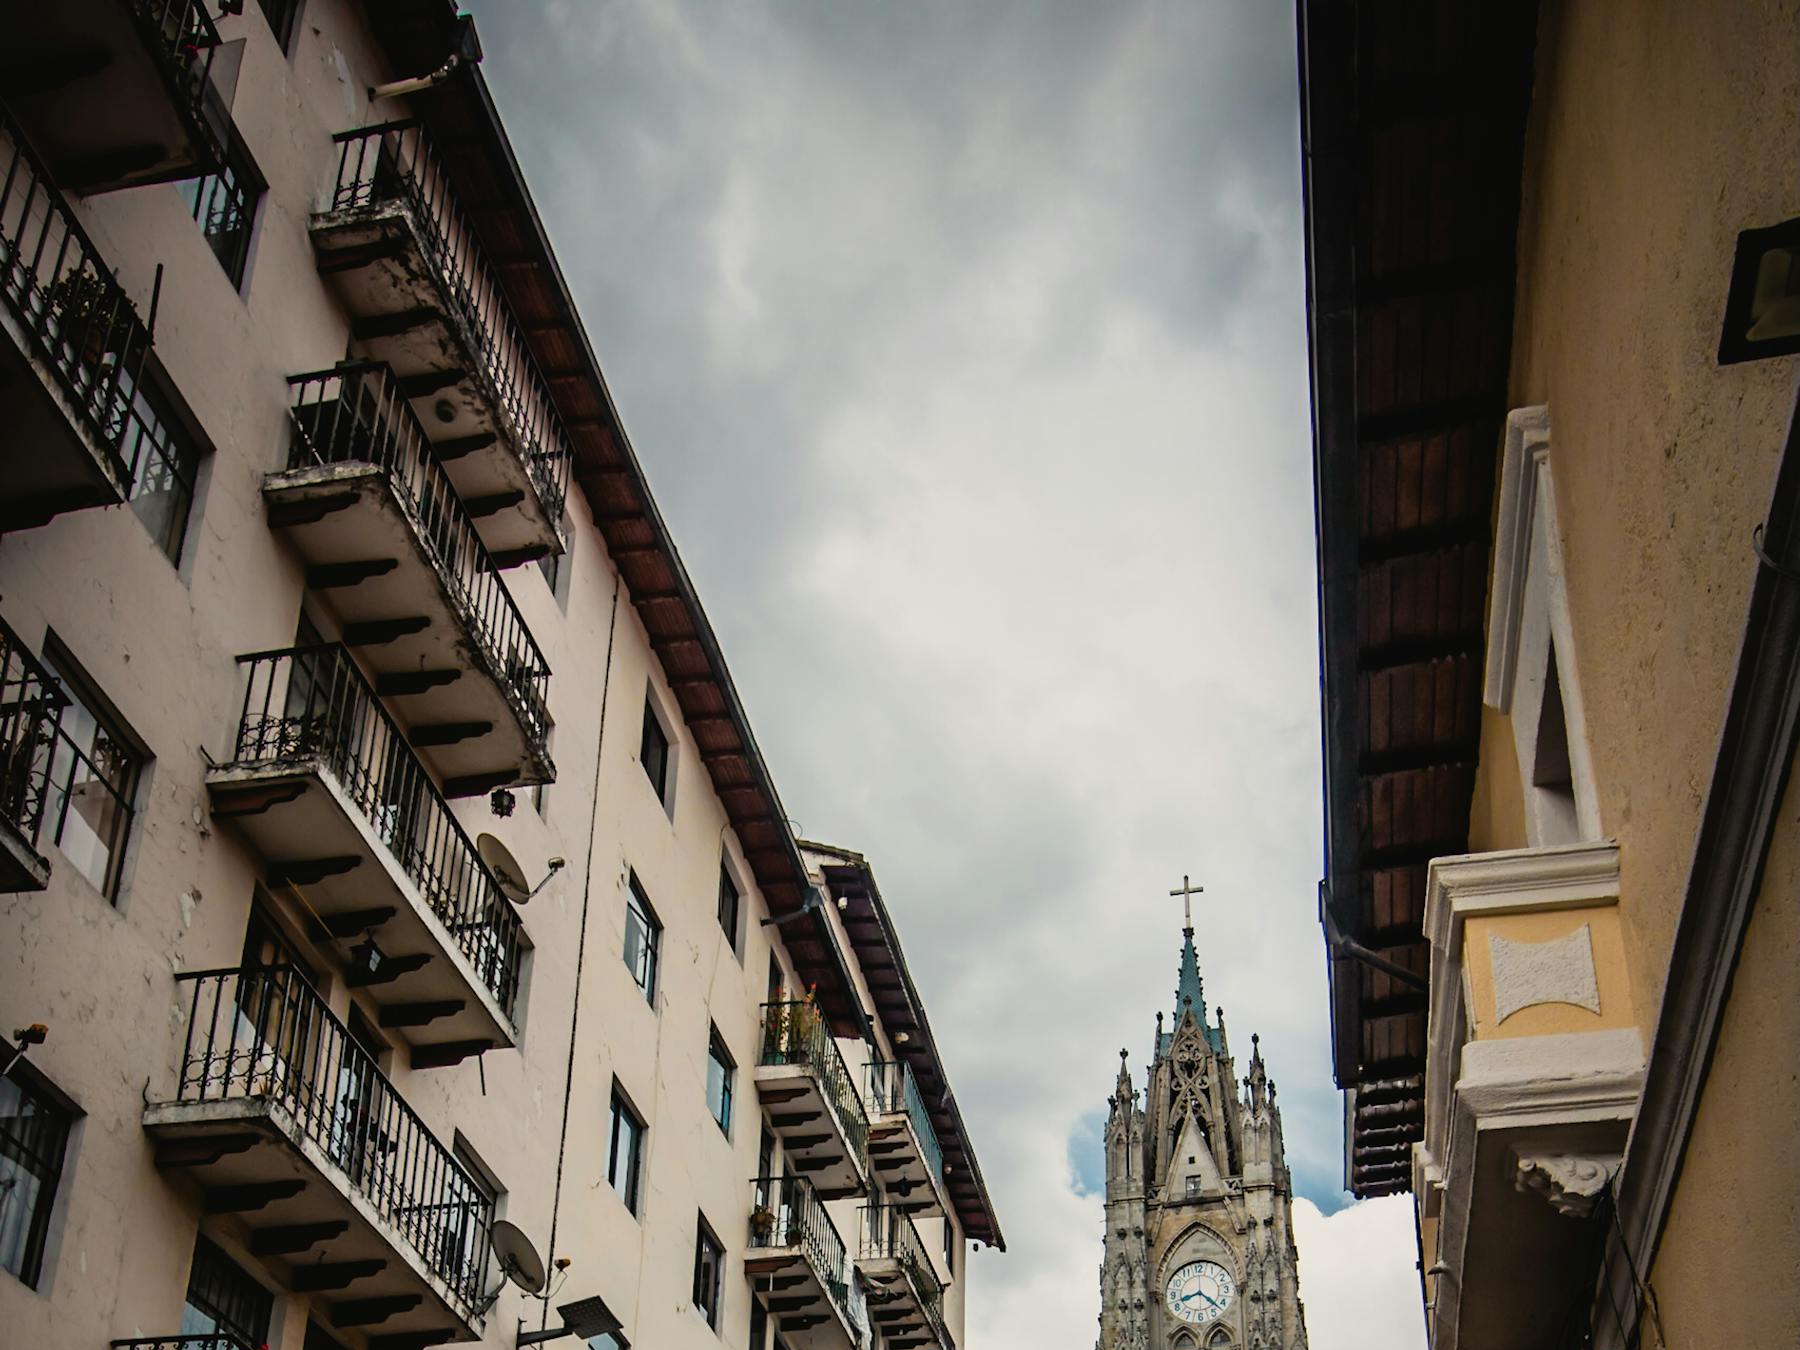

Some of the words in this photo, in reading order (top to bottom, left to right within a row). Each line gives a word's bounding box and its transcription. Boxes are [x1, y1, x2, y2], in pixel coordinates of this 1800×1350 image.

[1182, 1268, 1190, 1277] 11
[1195, 1264, 1203, 1273] 12
[1219, 1273, 1226, 1282] 2
[1173, 1278, 1181, 1287] 10
[1224, 1285, 1229, 1293] 3
[1170, 1291, 1176, 1300] 9
[1220, 1298, 1226, 1307] 4
[1174, 1303, 1180, 1312] 8
[1185, 1311, 1191, 1320] 7
[1198, 1312, 1204, 1321] 6
[1211, 1308, 1217, 1317] 5
